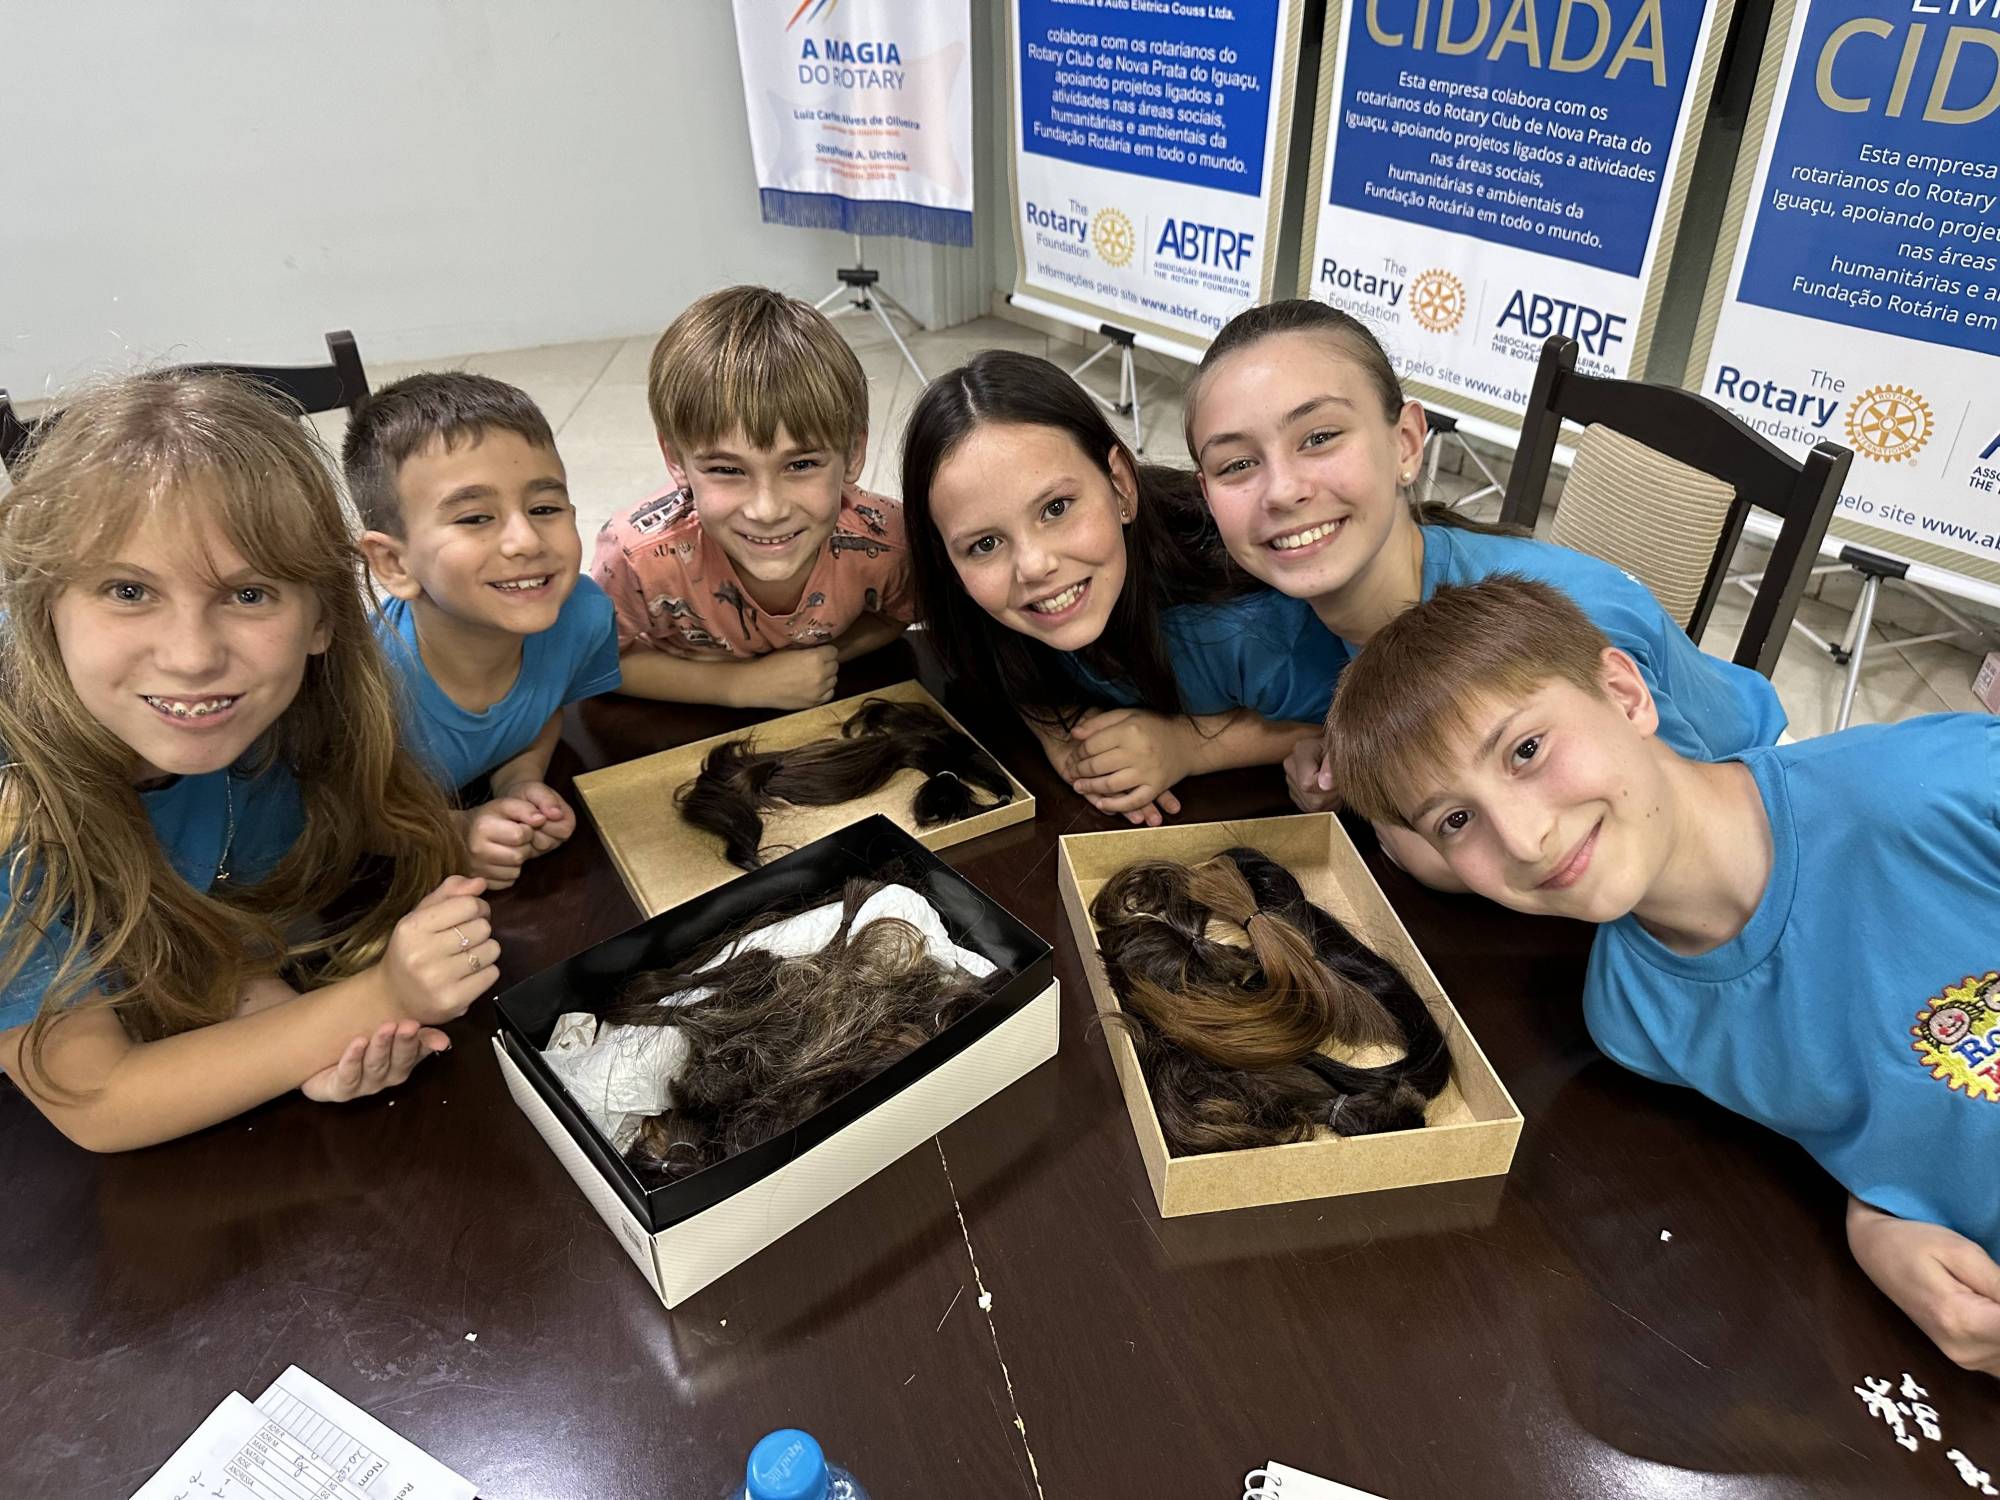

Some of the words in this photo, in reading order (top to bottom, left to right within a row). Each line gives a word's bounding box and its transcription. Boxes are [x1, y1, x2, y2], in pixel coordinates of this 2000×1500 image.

[1171, 2, 1206, 18] Couss
[1208, 5, 1235, 21] Ltda.
[801, 39, 819, 60] A
[825, 39, 902, 65] MAGIA
[1047, 28, 1098, 47] colabora
[1101, 37, 1128, 50] com
[1131, 40, 1146, 53] os
[1150, 41, 1216, 60] rotarianos
[1218, 46, 1238, 64] do
[799, 65, 830, 85] DO
[833, 66, 905, 90] ROTARY
[1028, 43, 1064, 66] Rotary
[1065, 49, 1094, 67] Club
[1097, 54, 1113, 70] de
[1116, 57, 1150, 76] Nova
[1152, 61, 1188, 81] Prata
[1190, 65, 1209, 83] do
[1211, 68, 1261, 91] Iguaçu,
[1054, 70, 1110, 91] apoiando
[1112, 78, 1163, 99] projetos
[1165, 83, 1211, 105] ligados
[1215, 93, 1225, 106] a
[1399, 71, 1426, 90] Esta
[1429, 78, 1489, 101] empresa
[1491, 84, 1551, 111] colabora
[1554, 98, 1587, 118] com
[1589, 104, 1609, 122] os
[869, 115, 882, 125] de
[1051, 106, 1124, 132] humanitárias
[1126, 122, 1136, 134] e
[1138, 123, 1207, 146] ambientais
[1209, 132, 1227, 149] da
[1052, 88, 1110, 111] atividades
[1113, 99, 1136, 115] nas
[1138, 101, 1174, 120] áreas
[1177, 107, 1226, 129] sociais,
[1356, 90, 1421, 113] rotarianos
[1424, 98, 1441, 117] do
[1444, 105, 1490, 128] Rotary
[1491, 110, 1522, 131] Club
[1525, 116, 1543, 135] de
[1547, 121, 1584, 143] Nova
[1588, 130, 1627, 151] Prata
[1630, 135, 1652, 155] do
[1034, 121, 1086, 146] Fundação
[1088, 133, 1131, 155] Rotária
[1133, 143, 1154, 158] em
[1156, 145, 1185, 164] todo
[1188, 152, 1197, 165] o
[1199, 152, 1248, 174] mundo.
[1346, 110, 1389, 133] Iguaçu,
[1391, 122, 1452, 144] apoiando
[1455, 130, 1509, 155] projetos
[1513, 139, 1563, 166] ligados
[1566, 153, 1576, 168] a
[1579, 154, 1656, 184] atividades
[1859, 144, 1901, 166] Esta
[1906, 153, 1998, 179] empresa
[1430, 151, 1453, 168] nas
[1456, 153, 1493, 176] áreas
[1495, 162, 1544, 188] sociais,
[1791, 165, 1890, 193] rotarianos
[1895, 179, 1921, 198] do
[1926, 183, 1997, 213] Rotary
[1068, 198, 1088, 216] The
[1388, 163, 1474, 196] humanitárias
[1476, 182, 1485, 197] e
[1486, 182, 1562, 215] ambientais
[1566, 201, 1584, 220] da
[1772, 189, 1836, 217] Iguaçu,
[1841, 204, 1935, 231] apoiando
[1026, 201, 1088, 243] Rotary
[1364, 182, 1425, 208] Fundação
[1427, 194, 1474, 218] Rotária
[1477, 207, 1498, 224] em
[1500, 211, 1533, 234] todo
[1535, 220, 1545, 234] o
[1548, 225, 1603, 249] mundo.
[1036, 233, 1090, 259] Foundation
[1156, 218, 1254, 272] ABTRF
[1898, 242, 1933, 261] nas
[1938, 247, 1997, 271] áreas
[1037, 263, 1095, 289] Informações
[1097, 281, 1118, 298] pelo
[1120, 288, 1138, 302] site
[1154, 270, 1167, 278] THE
[1320, 258, 1403, 307] Rotary
[1383, 257, 1407, 278] The
[1830, 255, 1961, 295] humanitárias
[1966, 284, 1979, 298] e
[1328, 292, 1400, 325] Foundation
[1496, 289, 1627, 357] ABTRF
[1792, 276, 1882, 307] Fundação
[1887, 295, 1959, 323] Rotária
[1965, 313, 1998, 330] em
[1491, 342, 1507, 354] THE
[1493, 333, 1542, 353] ASSOCIAÇ
[1603, 364, 1616, 375] DA
[1405, 358, 1434, 377] pelo
[1438, 367, 1461, 385] site
[1465, 376, 1528, 405] www.abt
[1714, 365, 1839, 428] Rotary
[1810, 369, 1845, 393] The
[1878, 392, 1915, 406] ROTARY
[1968, 476, 1994, 492] THE
[1879, 504, 1915, 525] site
